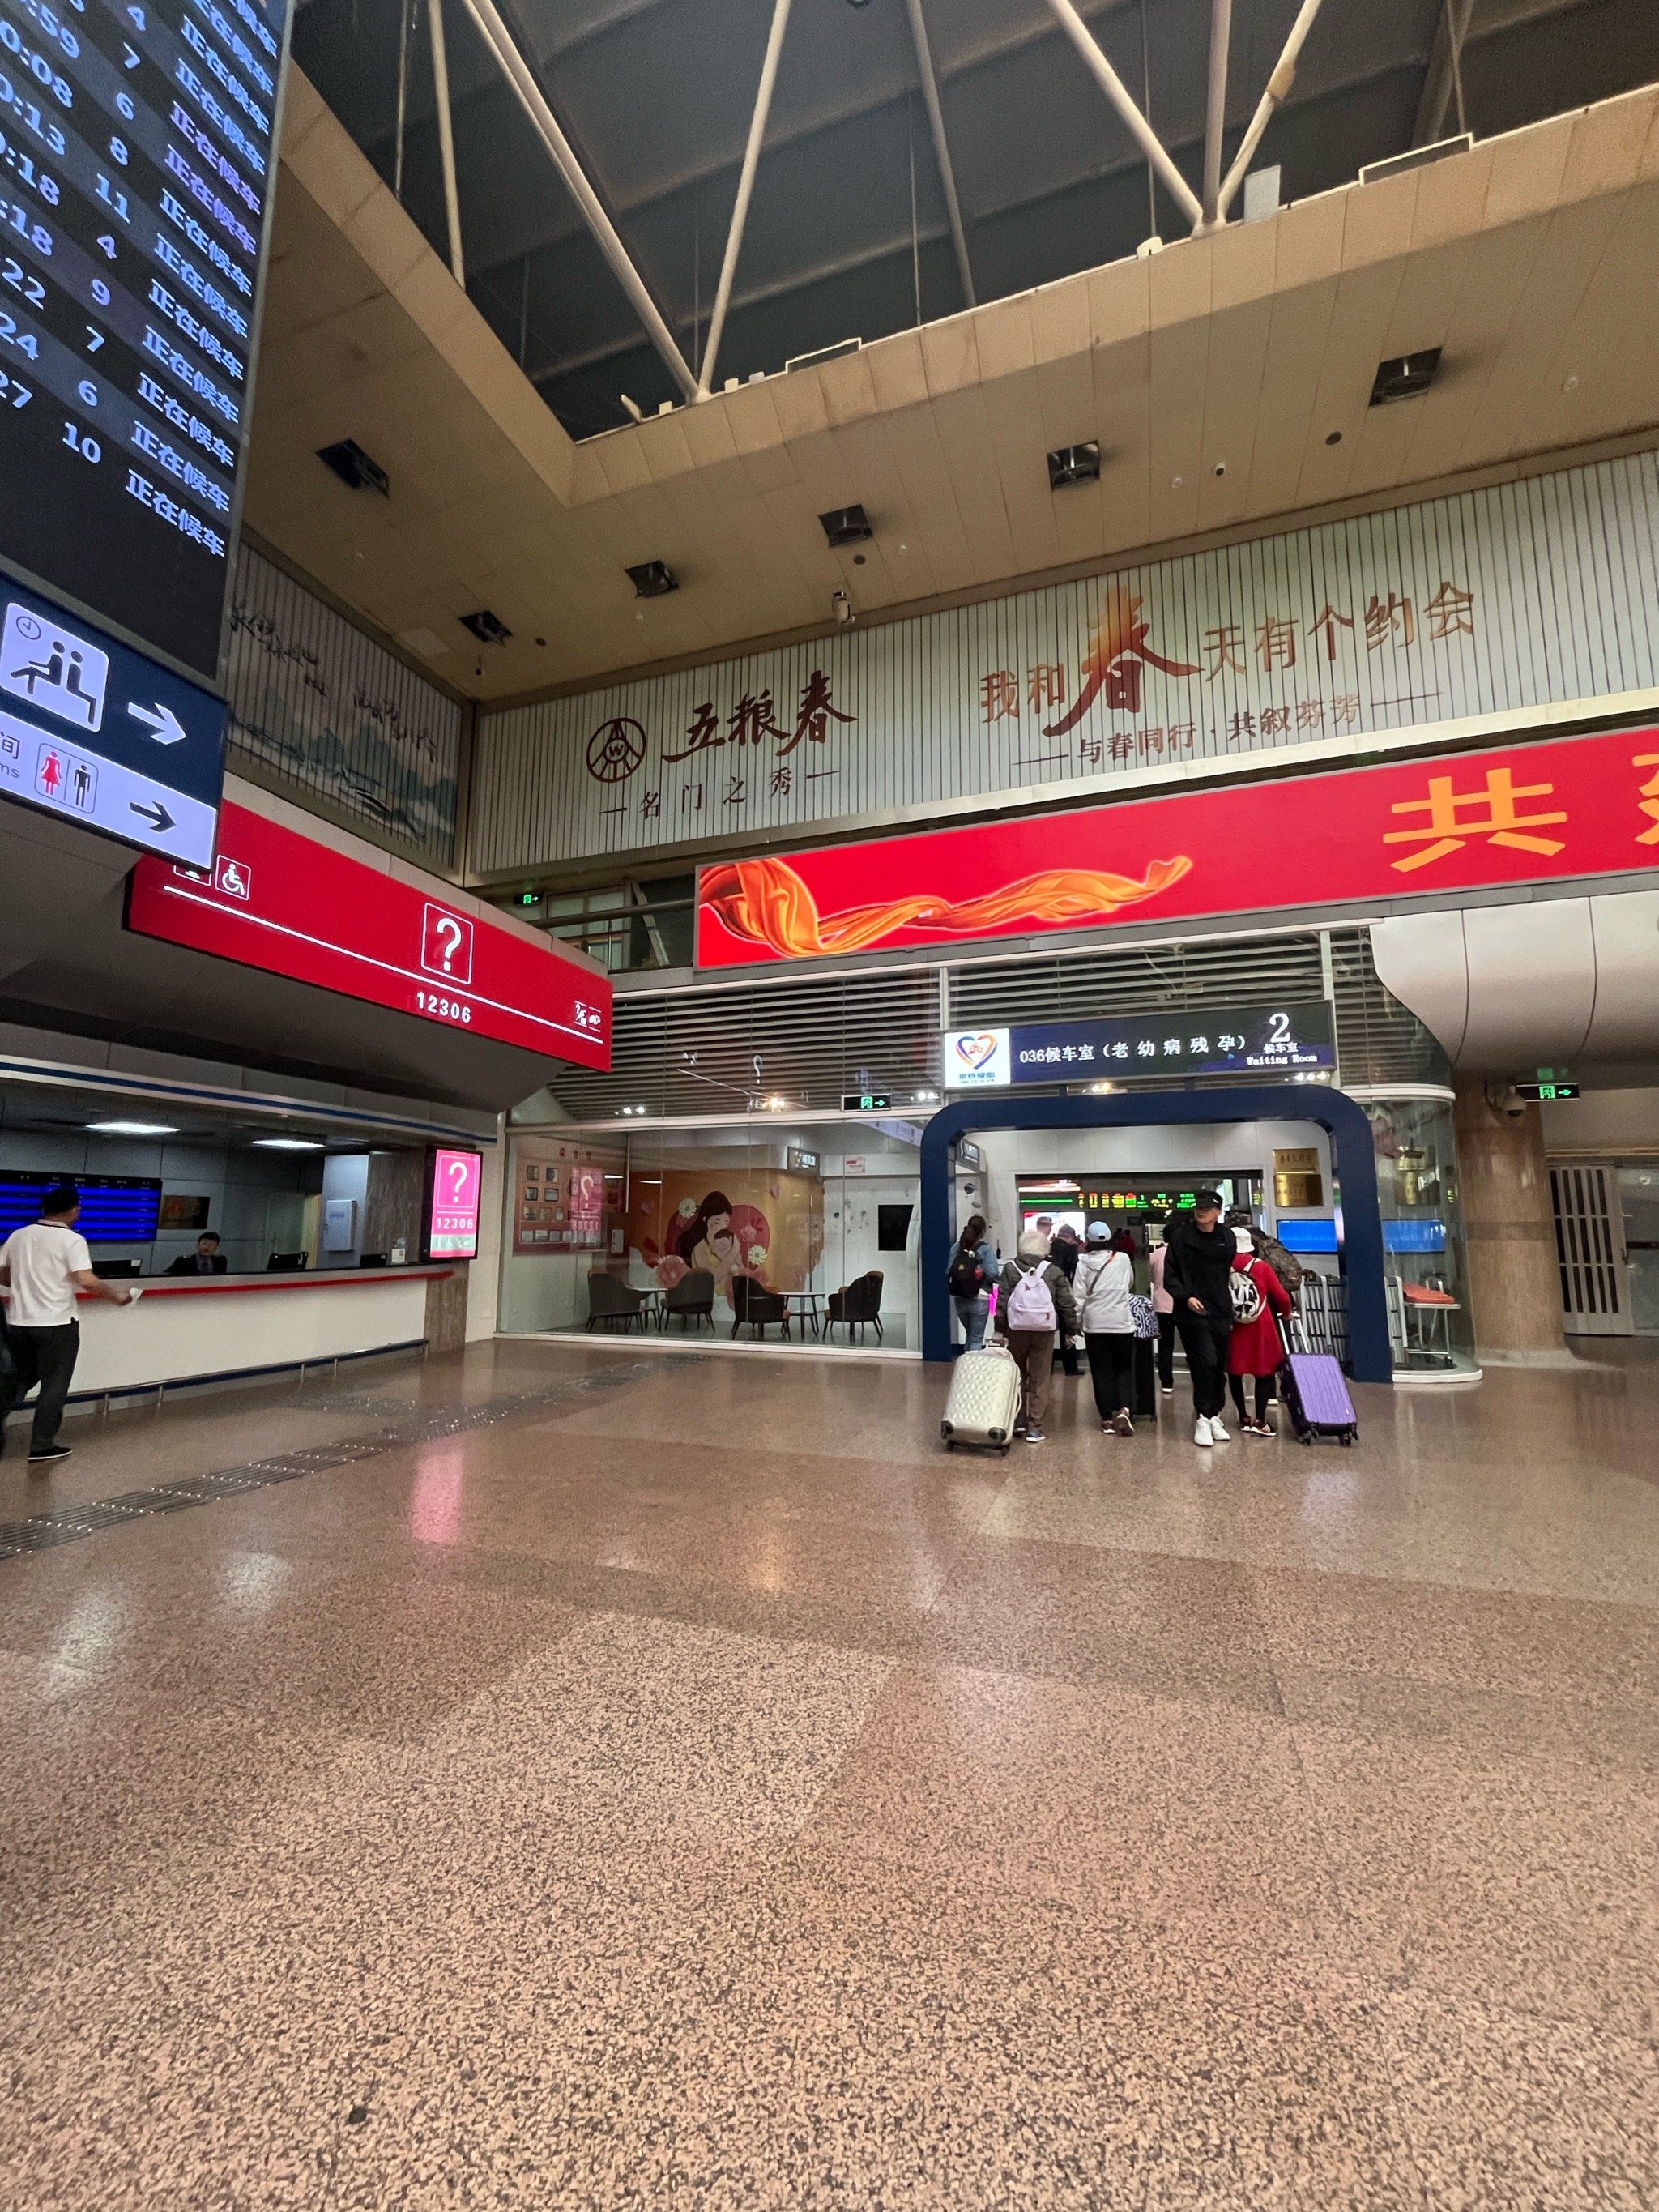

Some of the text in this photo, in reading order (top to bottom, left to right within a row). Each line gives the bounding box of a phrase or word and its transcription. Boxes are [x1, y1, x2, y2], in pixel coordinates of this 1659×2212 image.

[123, 42, 140, 69] 7
[127, 6, 146, 31] 4
[193, 0, 273, 97] 在候车
[116, 92, 134, 120] 6
[96, 173, 130, 224] 11
[154, 233, 247, 338] 正在候车
[110, 136, 128, 165] 8
[160, 188, 251, 297] 正在候车
[92, 279, 111, 306] 9
[143, 325, 239, 423] 正在候车
[96, 235, 117, 259] 4
[148, 278, 243, 380] 正在候车
[1, 258, 234, 467] 22 7 正在候车
[62, 421, 101, 463] 10
[126, 468, 225, 557] 正在候车
[79, 380, 97, 407] 6
[131, 420, 229, 512] 正在候车
[662, 670, 858, 762] 五粮春
[416, 991, 471, 1023] 12306
[1264, 1042, 1299, 1054] 候车室
[1269, 1013, 1290, 1043] 2
[1247, 1054, 1317, 1065] Waiting Room
[437, 1218, 474, 1229] 12306
